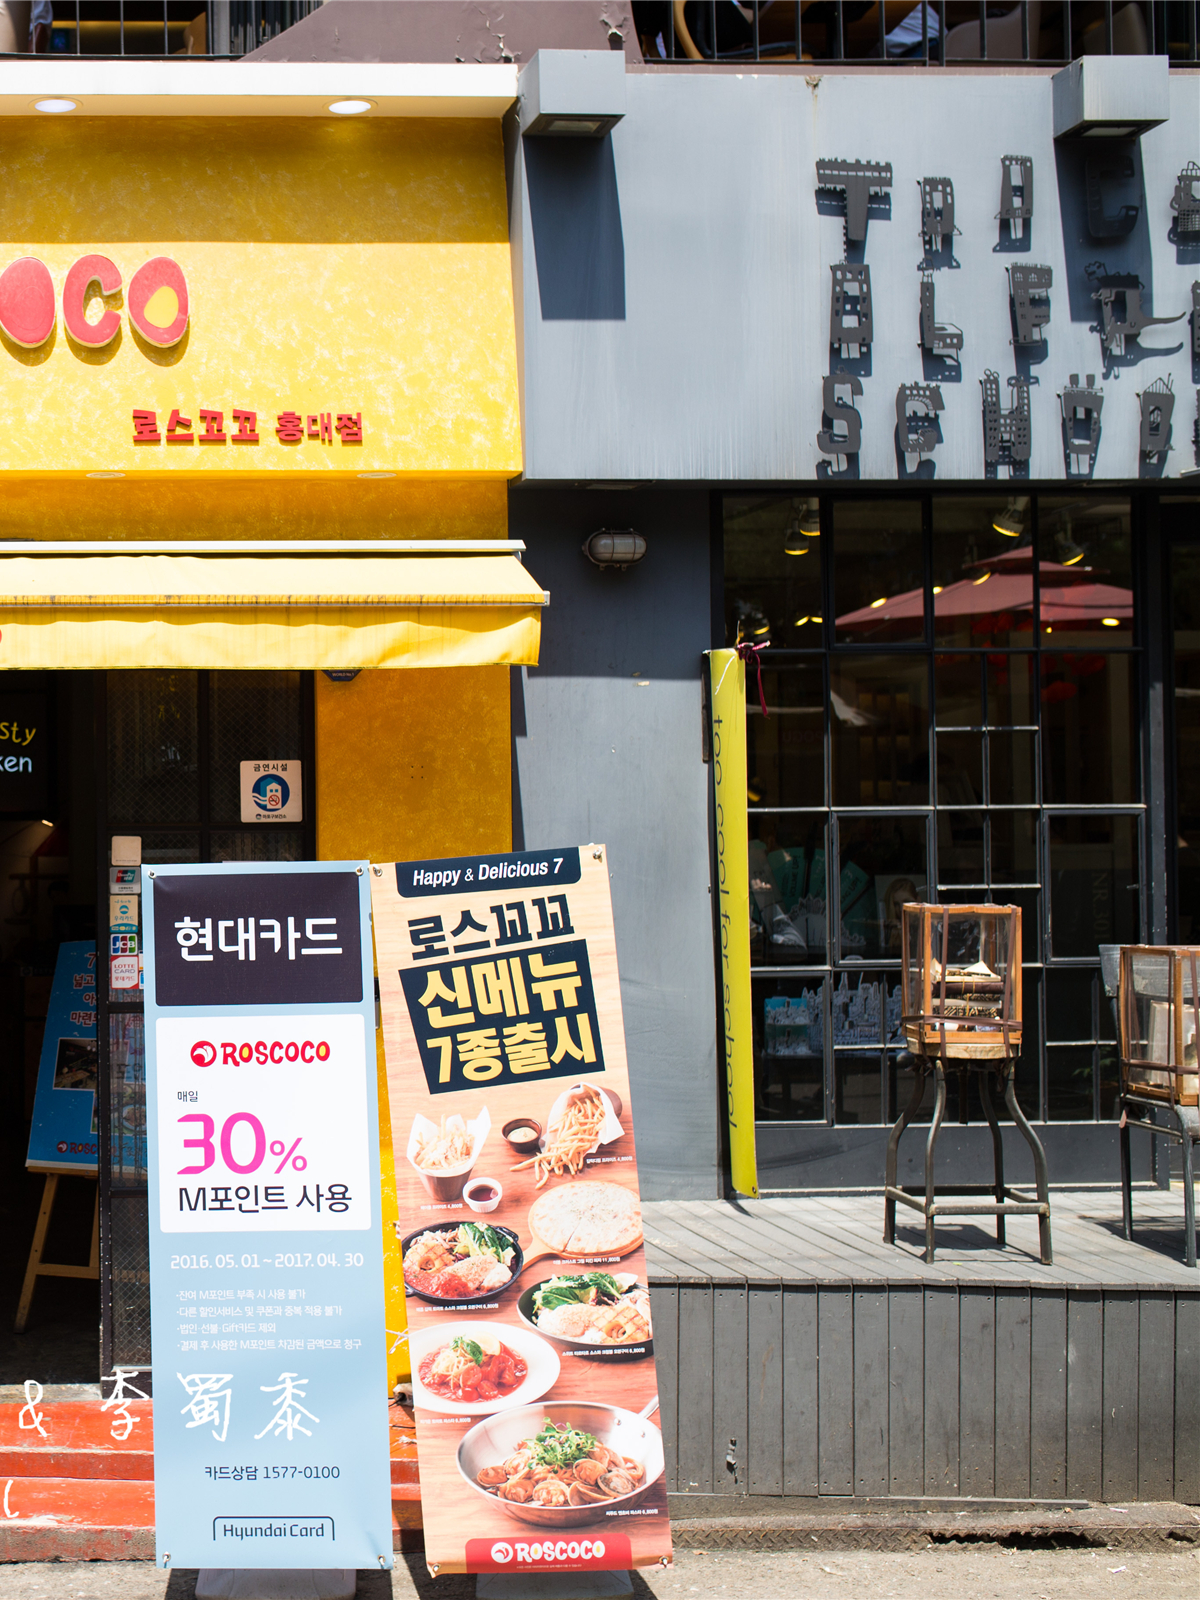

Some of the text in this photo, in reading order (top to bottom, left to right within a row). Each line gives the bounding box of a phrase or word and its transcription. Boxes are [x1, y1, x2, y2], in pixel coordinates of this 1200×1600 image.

[132, 408, 363, 446] 로스꼬꼬 홍대점
[713, 714, 723, 786] too
[253, 763, 288, 773] 금연시설
[717, 802, 730, 895] cool
[412, 857, 564, 887] Happy & Delicious 7
[112, 940, 136, 949] JCB
[174, 916, 343, 962] 현대카드
[720, 911, 731, 970] for
[417, 953, 583, 1030] 신메뉴
[220, 1040, 331, 1067] ROSCOCO
[426, 1012, 597, 1084] 7종출시
[724, 983, 738, 1129] school
[177, 1090, 199, 1103] 매일
[176, 1111, 308, 1175] 30%
[178, 1183, 353, 1213] M포인트 사용
[204, 1465, 341, 1481] 카드상담 1577-0100
[223, 1523, 325, 1541] Hyundai Card
[514, 1540, 605, 1563] ROSCOCO
